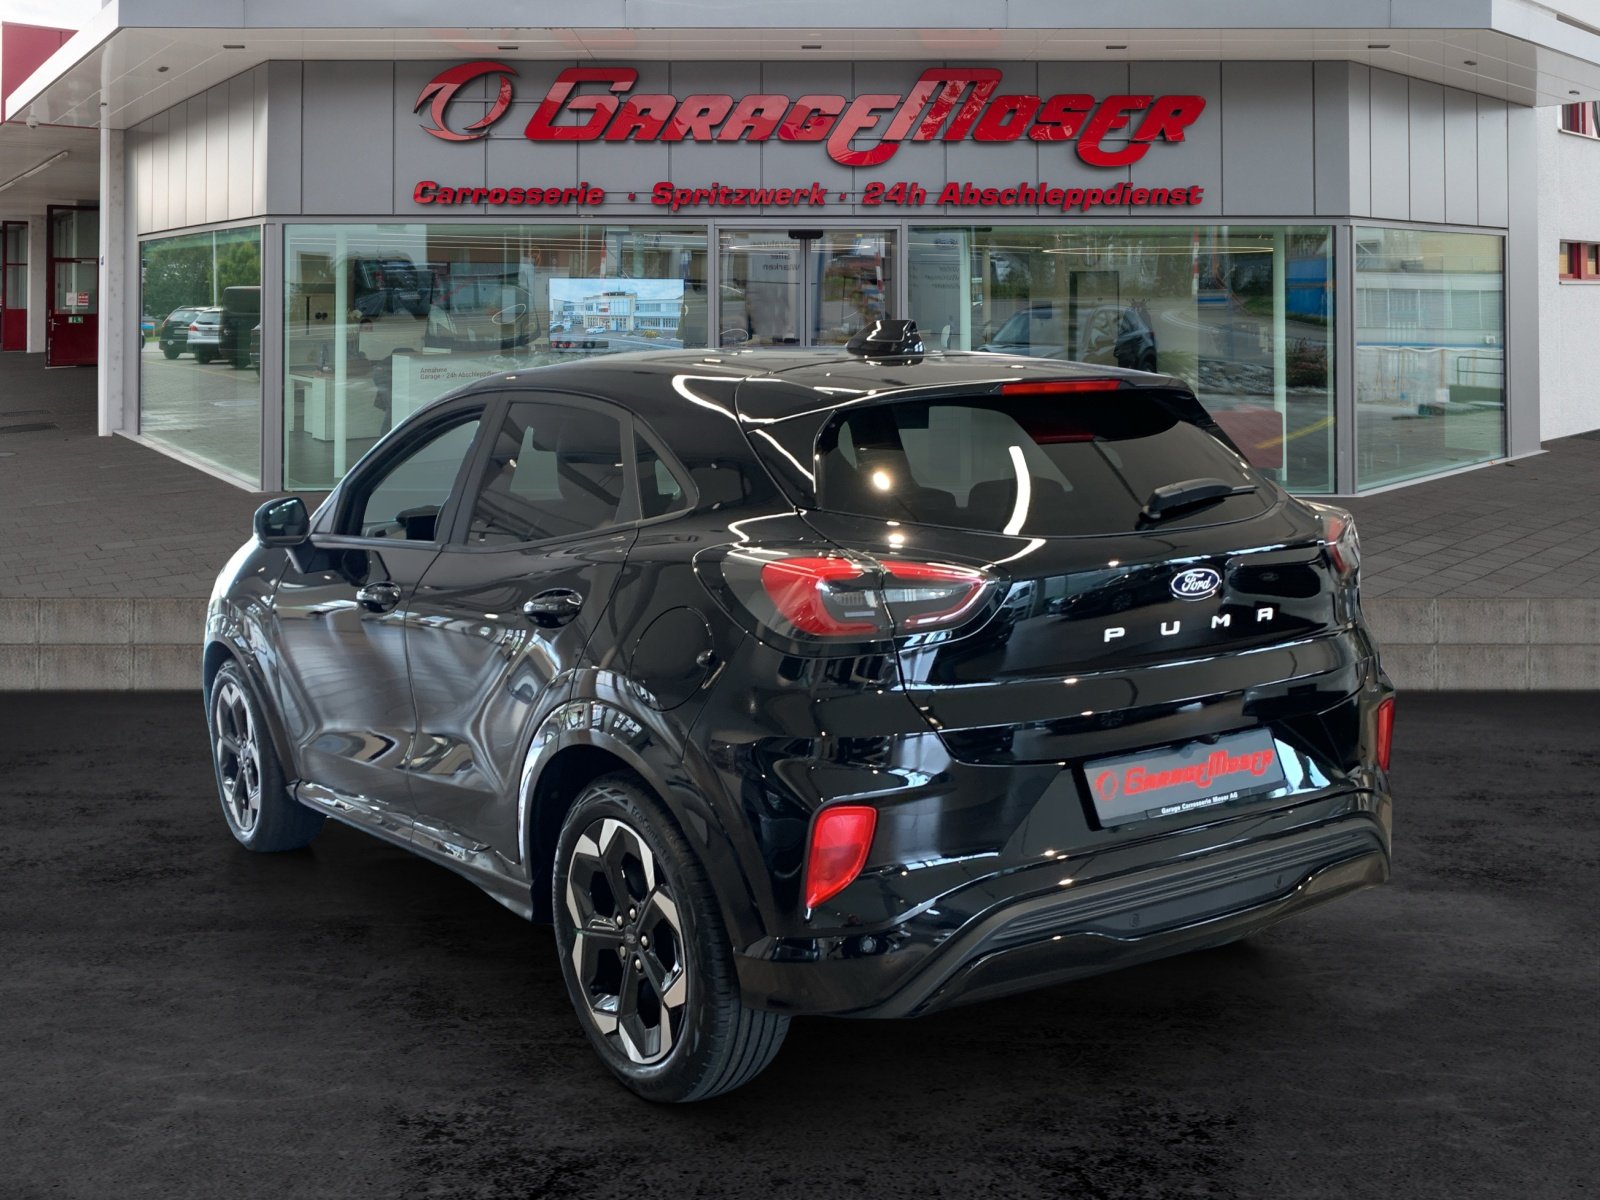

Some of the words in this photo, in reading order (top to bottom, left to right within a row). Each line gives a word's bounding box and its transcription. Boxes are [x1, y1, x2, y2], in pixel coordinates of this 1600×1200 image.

[413, 180, 605, 205] Carrosserie
[650, 181, 826, 211] Spritzwerk
[862, 181, 927, 206] 24h
[936, 181, 1204, 211] Abschleppdienst
[1181, 572, 1211, 592] Ford
[1104, 607, 1274, 642] PUMA
[1161, 805, 1181, 814] Garage
[1182, 798, 1211, 809] Carrosserie
